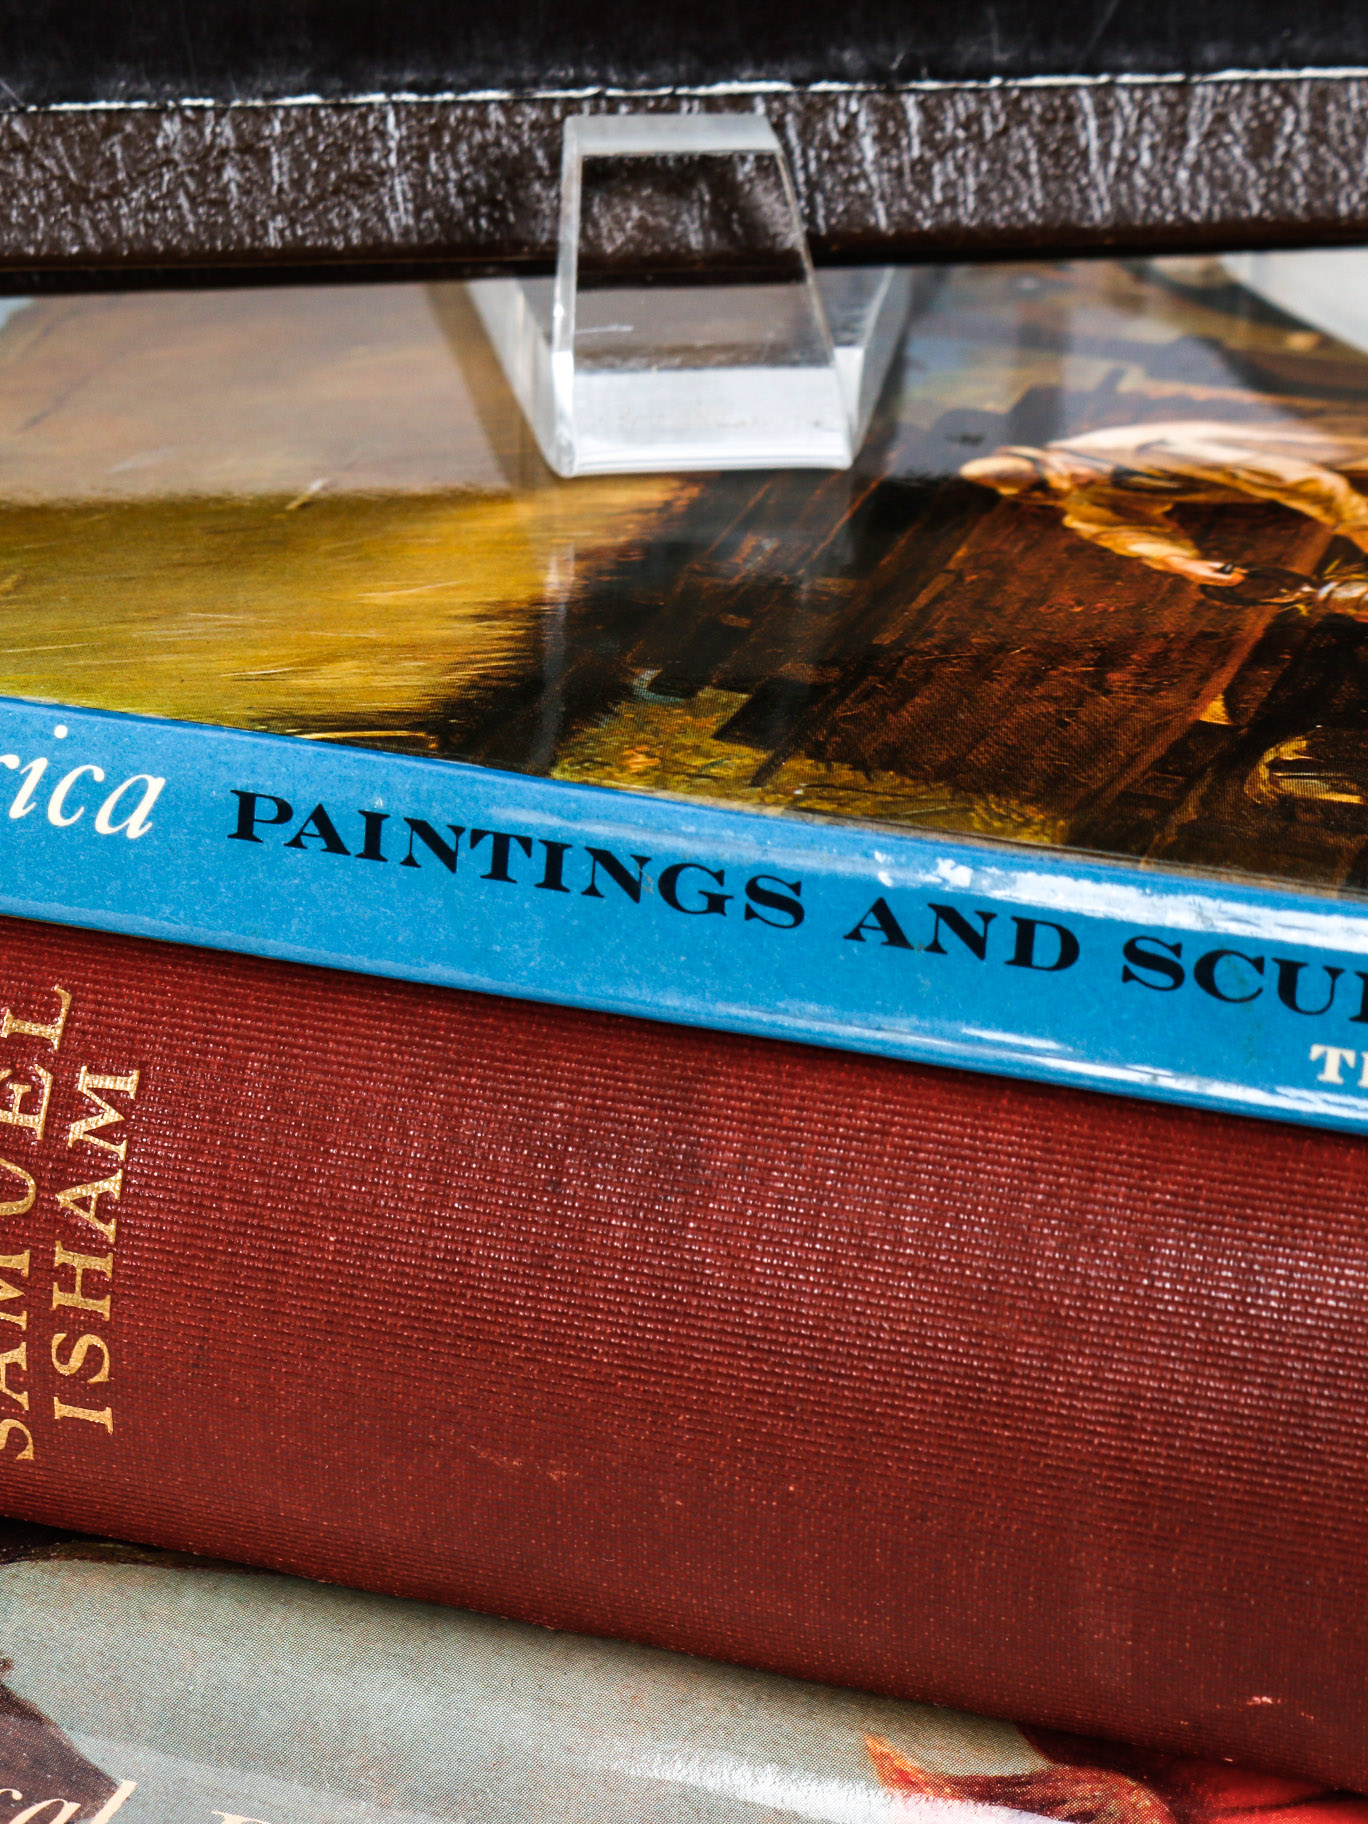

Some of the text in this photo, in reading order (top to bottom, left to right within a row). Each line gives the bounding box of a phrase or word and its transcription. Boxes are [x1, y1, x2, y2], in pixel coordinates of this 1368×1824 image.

[227, 789, 805, 929] PAINTINGS
[844, 896, 1079, 971] AND
[51, 1065, 140, 1435] ISHAM
